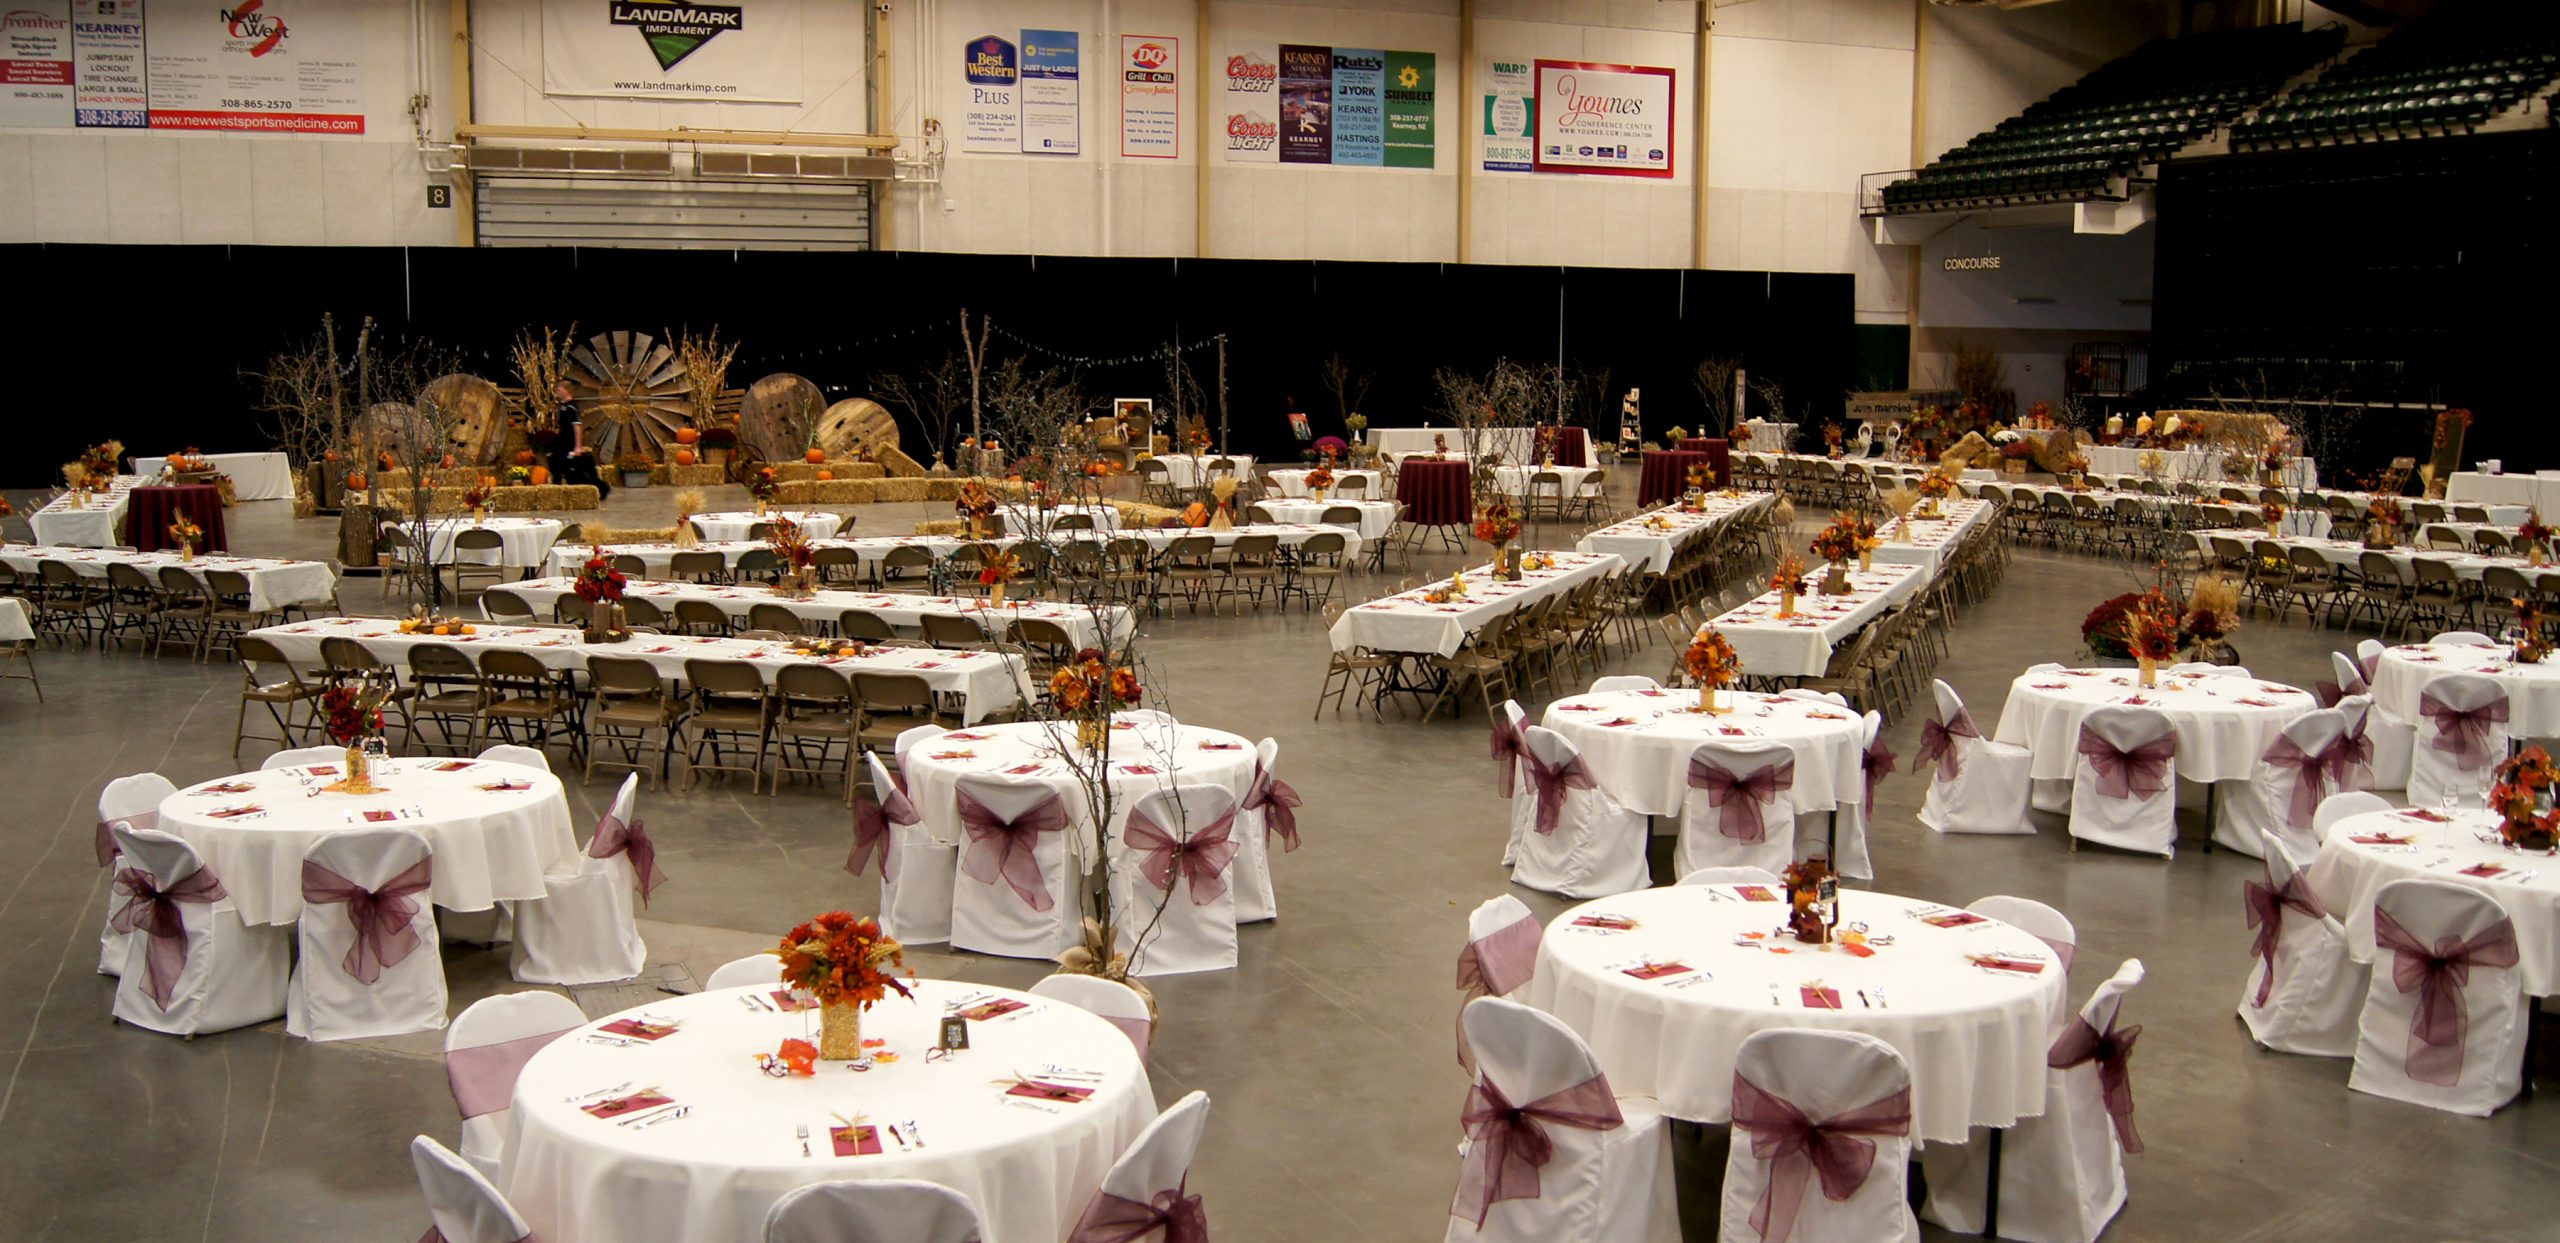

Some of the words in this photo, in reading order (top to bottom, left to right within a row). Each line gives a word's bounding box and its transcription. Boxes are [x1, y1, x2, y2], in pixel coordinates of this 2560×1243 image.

[220, 9, 262, 24] New
[75, 22, 141, 34] KEARNEY
[243, 22, 290, 39] West
[645, 25, 712, 35] IMPLEMENT
[85, 54, 134, 62] JUMPSTART
[977, 52, 1004, 66] Best
[1138, 48, 1164, 65] DQ
[1284, 51, 1327, 65] KEARNEY
[90, 65, 131, 73] LOCKOUT
[1052, 65, 1077, 73] LADIES
[1227, 55, 1277, 79] Coors
[1290, 65, 1322, 73] NEBRASKA
[1333, 55, 1383, 71] Rutt's
[1493, 62, 1528, 74] WARD
[967, 62, 1016, 79] Western
[1127, 72, 1147, 81] Grill
[104, 75, 138, 83] CHANGE
[1227, 77, 1274, 92] LIGHT
[78, 85, 107, 93] LARGE
[117, 86, 145, 94] SMALL
[614, 81, 737, 94] www.landmarkimp.com
[1348, 86, 1376, 97] YORK
[78, 96, 112, 104] 24-HOUR
[114, 96, 146, 105] TOWING
[974, 88, 1010, 105] PLUS
[1385, 89, 1434, 101] SUNBELT
[1556, 74, 1643, 127] Younes
[220, 99, 293, 110] 308-865-2570
[1337, 105, 1379, 115] KEARNEY
[79, 110, 146, 126] 308-236-9951
[150, 114, 358, 131] www.newwestsportsmedicine.com
[966, 113, 985, 121] (308)
[1227, 114, 1278, 137] Coors
[1391, 122, 1418, 131] Kearney,
[1576, 120, 1623, 129] CONFERENCE
[1625, 122, 1653, 130] CENTER
[1558, 127, 1620, 136] WWW.YOUNES.COM
[966, 135, 1017, 143] bestwestern.com
[1227, 136, 1275, 151] LIGHT
[1336, 133, 1381, 143] HASTINGS
[1486, 147, 1531, 160] 800-887-7645
[433, 188, 445, 204] 8
[1944, 256, 2001, 271] CONCOURSE
[1874, 403, 1912, 413] married
